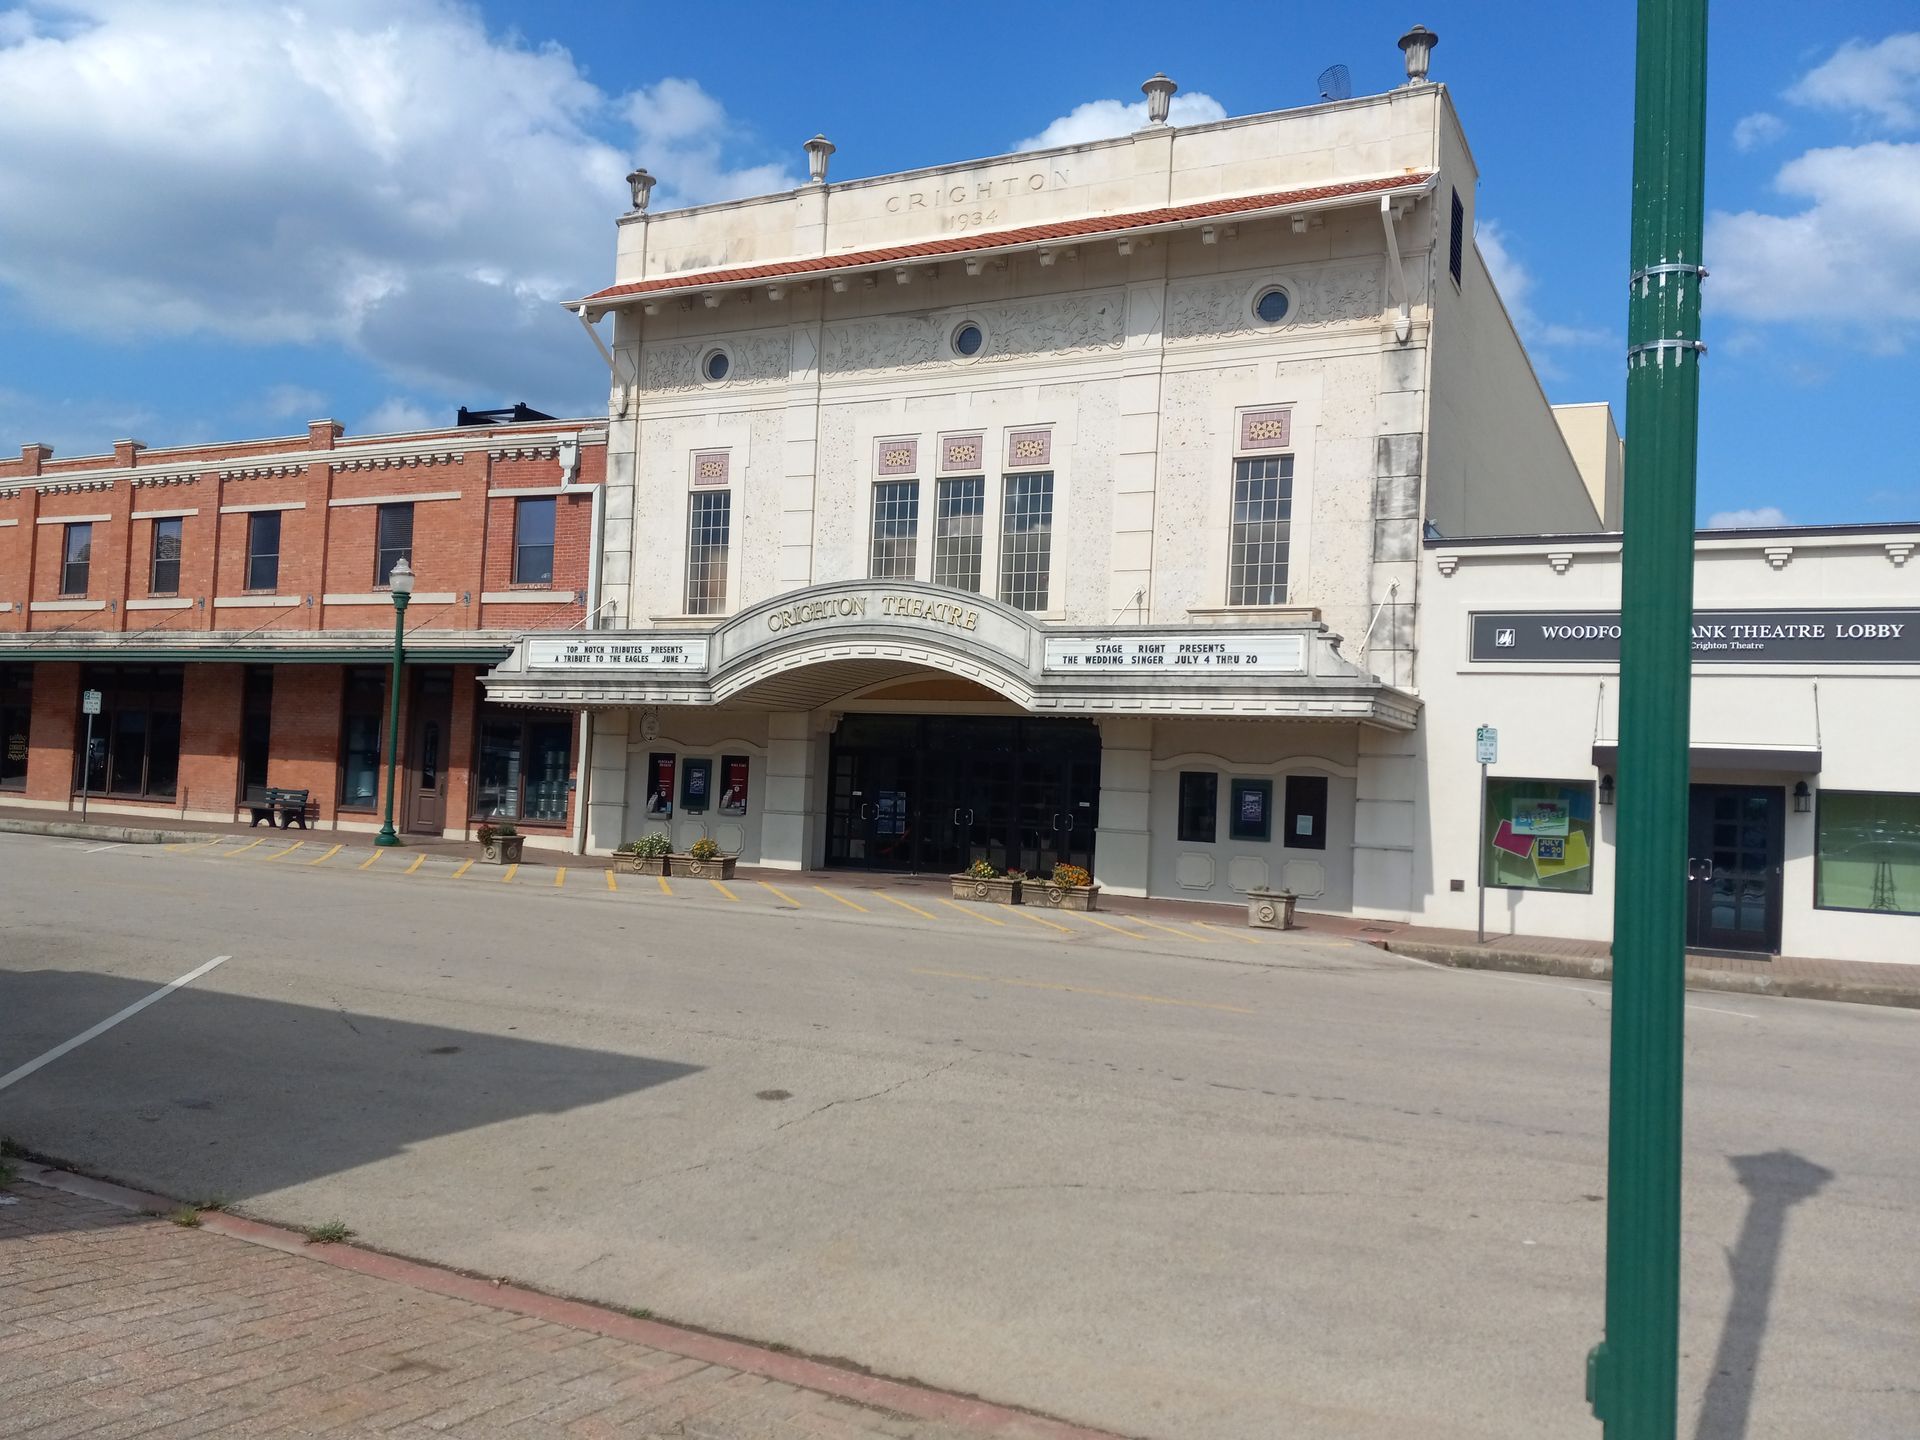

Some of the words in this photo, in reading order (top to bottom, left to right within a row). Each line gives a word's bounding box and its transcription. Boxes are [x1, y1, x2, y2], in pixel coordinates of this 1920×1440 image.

[886, 169, 1069, 213] CRIGHTON
[949, 209, 999, 231] 1934
[767, 597, 866, 632] CRIGHTON
[880, 596, 979, 631] THEATRE
[1542, 625, 1621, 639] WOODFO
[1730, 624, 1826, 639] THEATRE
[1835, 624, 1905, 638] LOBBY
[1095, 645, 1123, 653] STAGE
[1138, 644, 1165, 653] RIGHT
[1179, 644, 1225, 653] PRESENTS
[1691, 641, 1728, 651] Crighton
[1729, 641, 1765, 650] Theatre
[1062, 656, 1078, 664] THE
[1085, 656, 1123, 664] WEDDING
[1131, 656, 1163, 664] SINGER
[1174, 655, 1198, 664] JULY
[1204, 655, 1210, 664] 4
[1216, 655, 1240, 664] THRU
[1246, 655, 1258, 664] 20
[1478, 730, 1483, 739] 2
